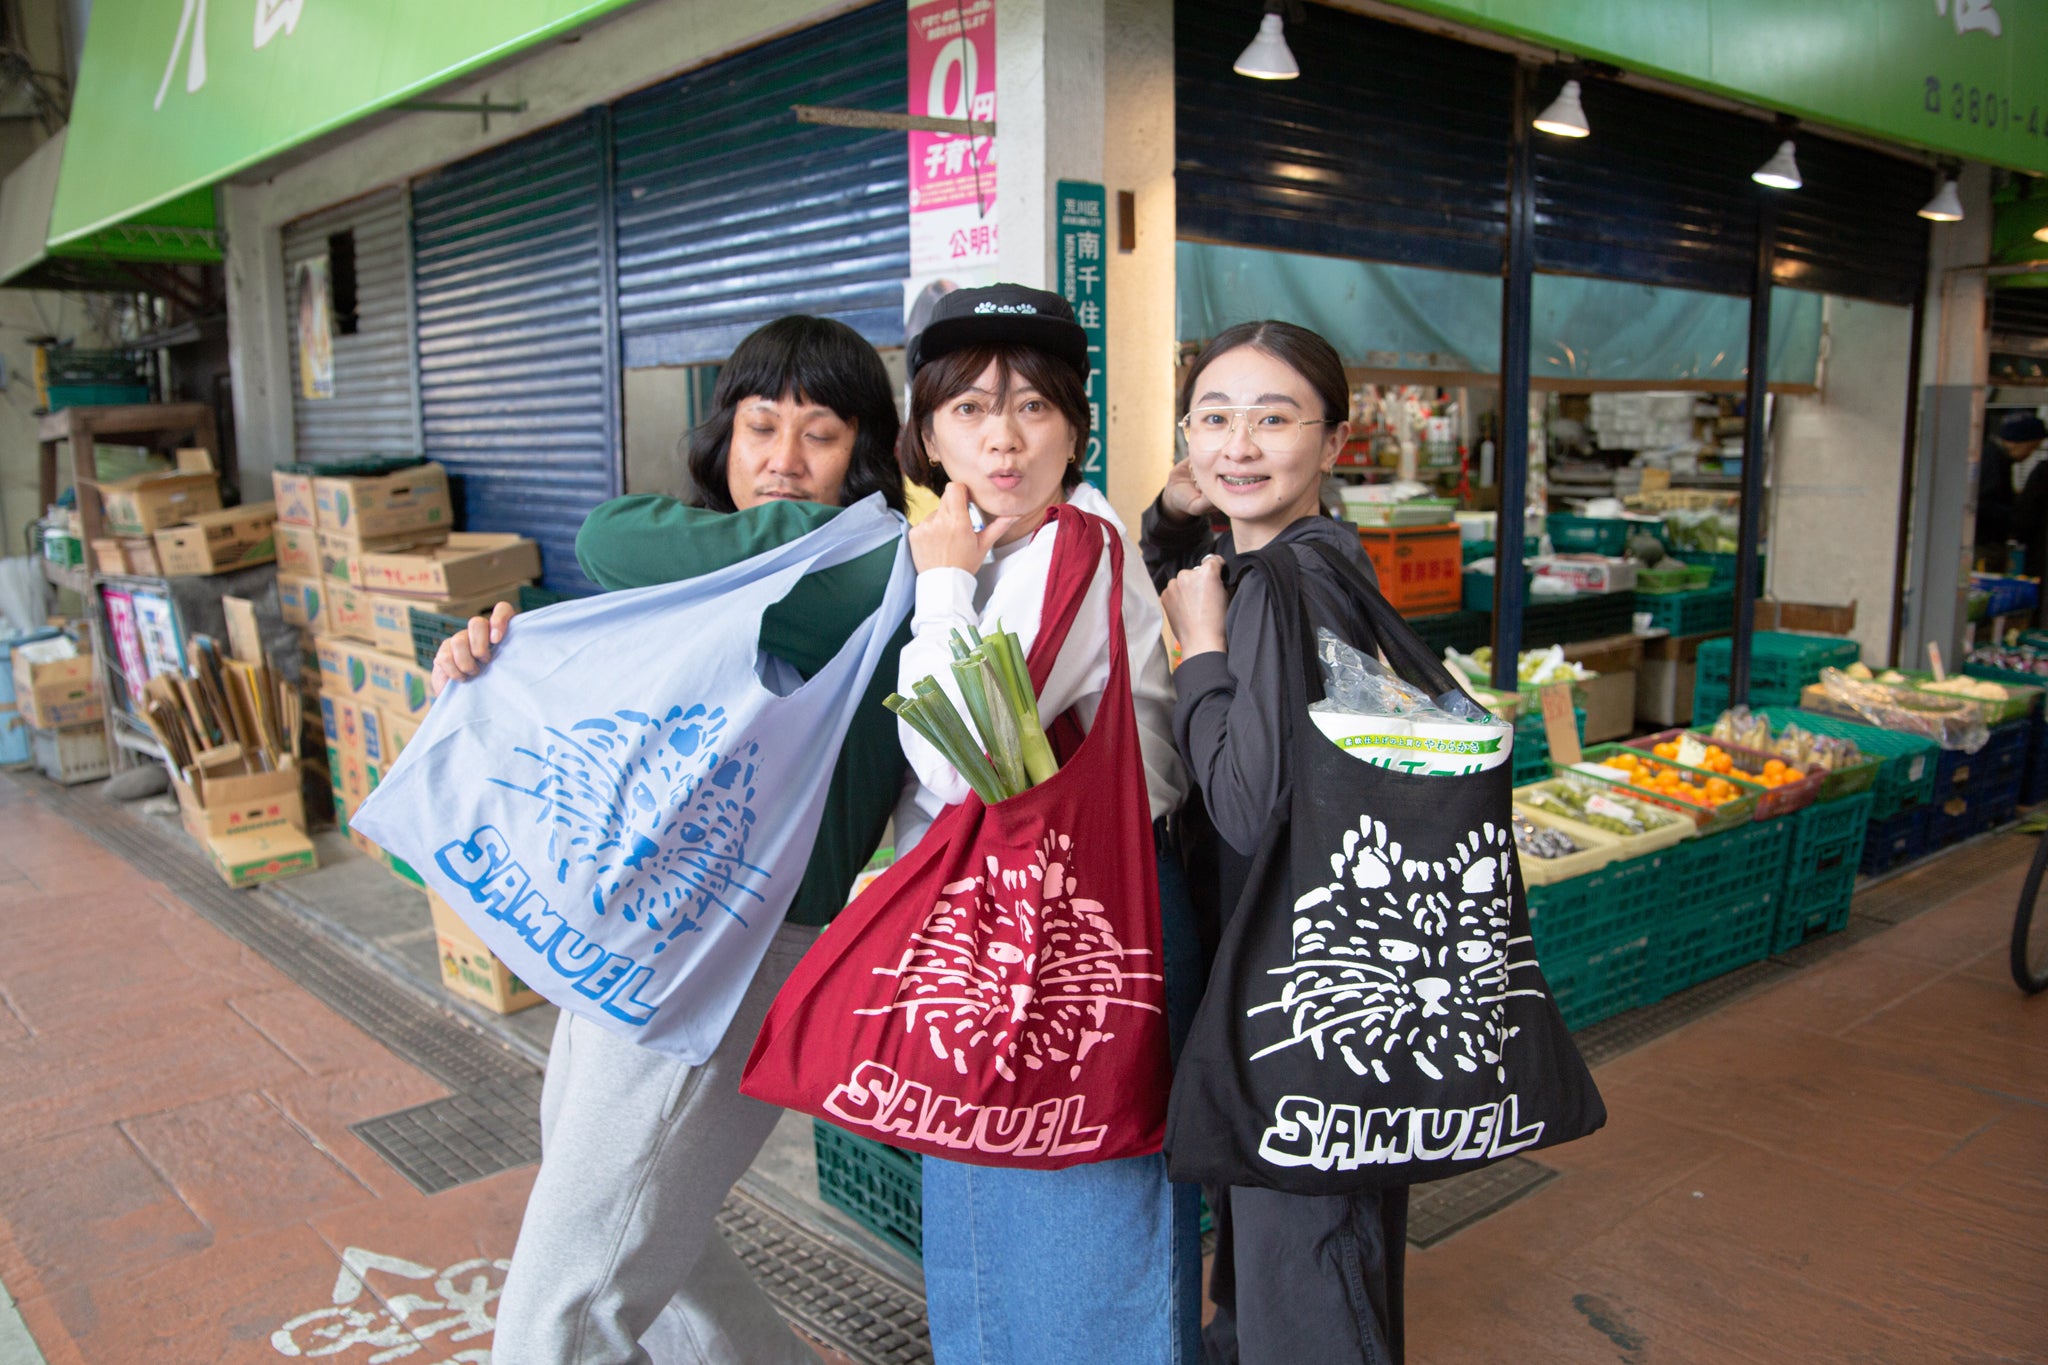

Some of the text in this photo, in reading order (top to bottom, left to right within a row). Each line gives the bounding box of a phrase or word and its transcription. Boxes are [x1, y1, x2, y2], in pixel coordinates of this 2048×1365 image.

[1951, 82, 2048, 139] 3801-4
[950, 224, 998, 258] 公明
[434, 824, 660, 1026] SAMUEL
[823, 1059, 1109, 1157] SAMUEL
[1258, 1094, 1546, 1172] SAMUEL
